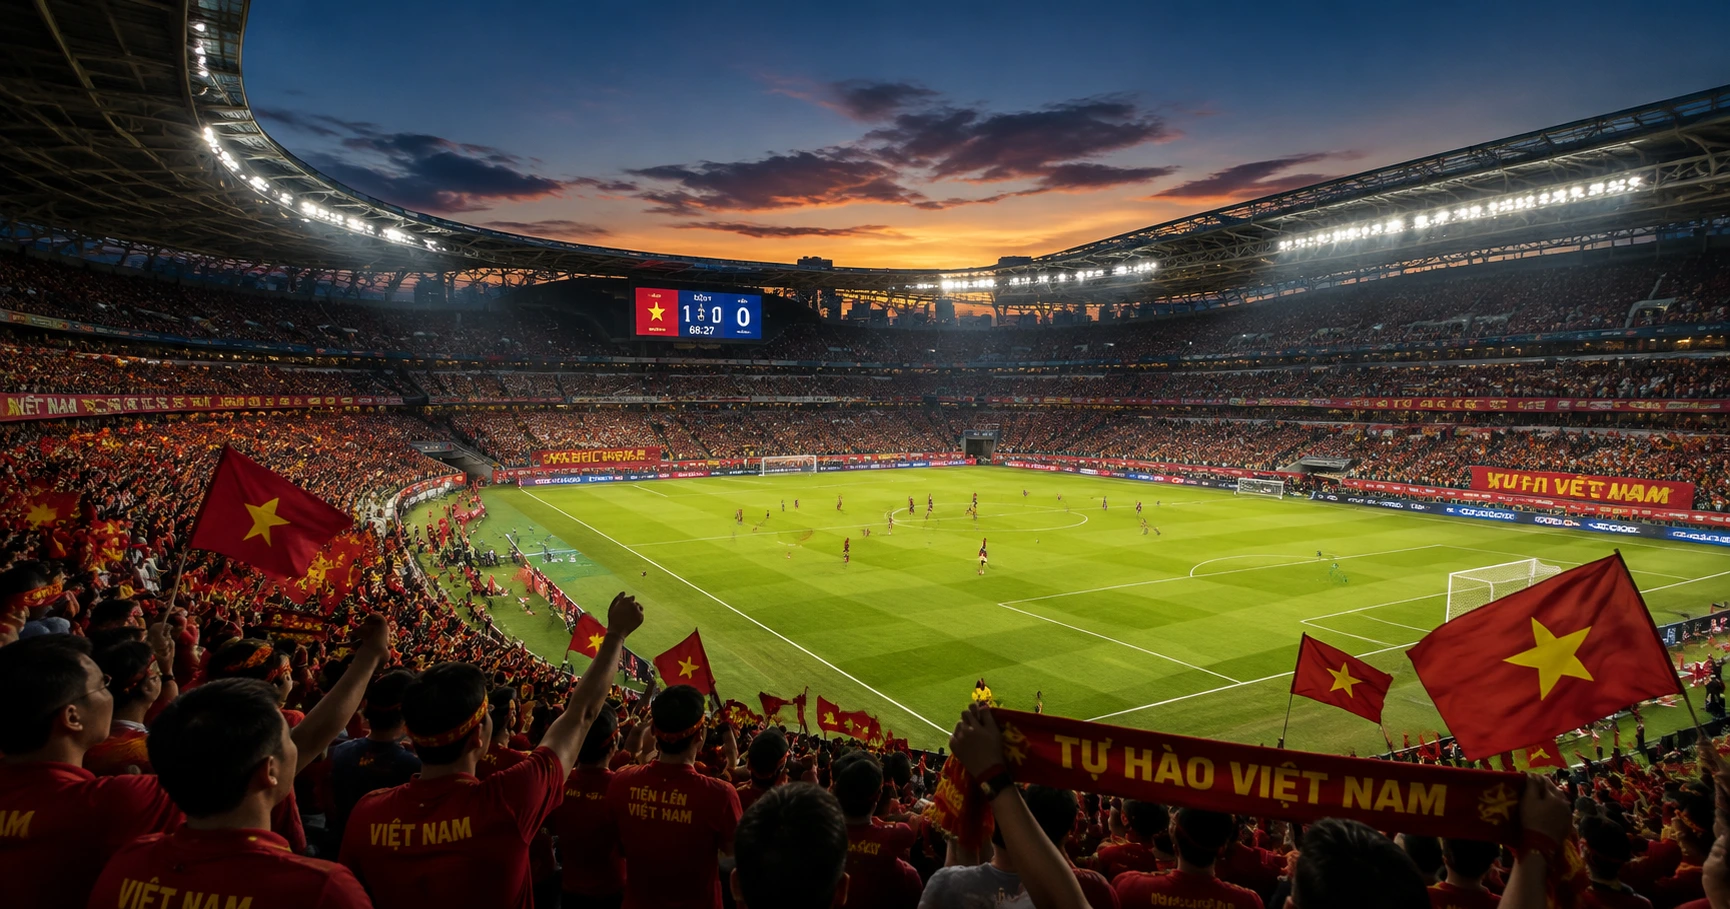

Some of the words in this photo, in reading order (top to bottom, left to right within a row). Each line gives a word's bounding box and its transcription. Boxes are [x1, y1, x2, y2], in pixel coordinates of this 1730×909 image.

[683, 305, 690, 322] 1
[737, 307, 750, 327] 0
[689, 325, 715, 335] 68:27
[1054, 734, 1113, 781] TỰ
[1124, 744, 1215, 791] HÀO
[1229, 760, 1329, 810] VIỆT
[1342, 775, 1448, 817] NAM
[370, 817, 416, 851] VIỆT
[422, 816, 473, 846] NAM
